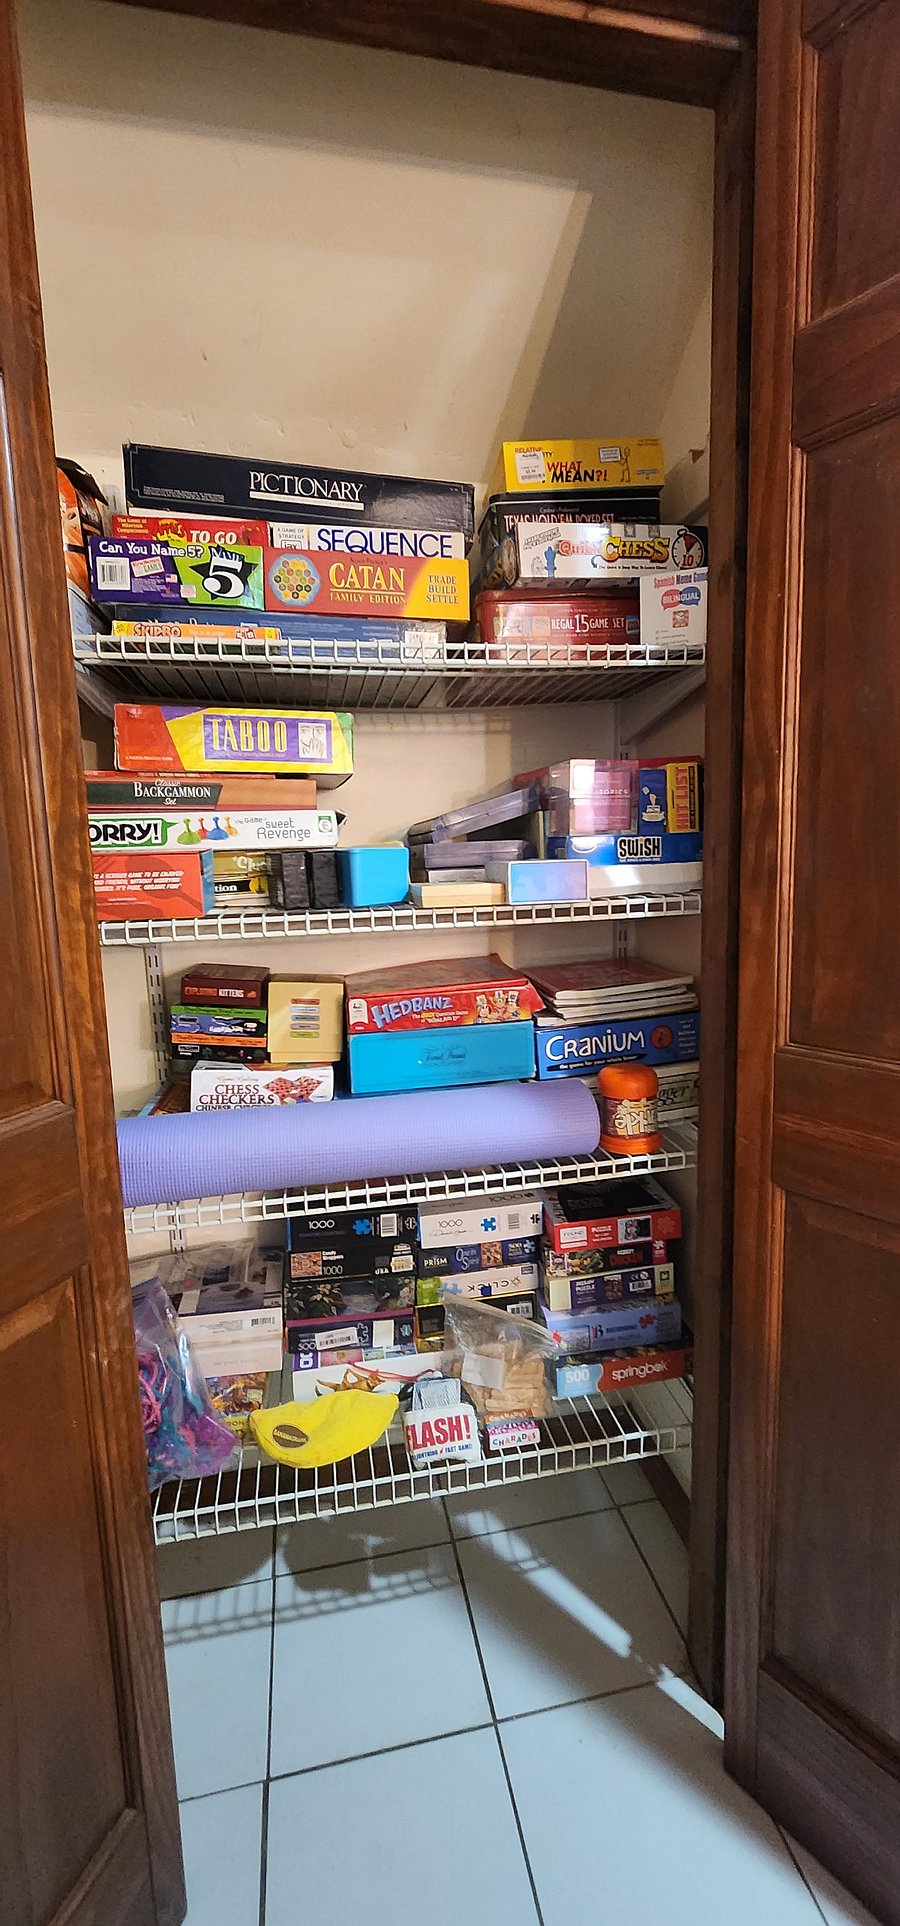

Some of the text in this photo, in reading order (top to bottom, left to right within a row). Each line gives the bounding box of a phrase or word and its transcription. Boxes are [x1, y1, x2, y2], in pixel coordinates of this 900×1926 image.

[547, 461, 582, 472] WHAT
[551, 469, 609, 483] MEAN?!
[249, 471, 364, 501] PICTIONARY
[190, 530, 237, 545] TO GO
[317, 528, 452, 558] SEQUENCE
[99, 541, 204, 558] Can You Name 5?
[682, 554, 694, 567] 10
[203, 555, 245, 599] 5
[328, 562, 405, 591] CATAN
[428, 575, 456, 584] TRADE
[654, 576, 675, 588] Spanish
[428, 585, 456, 594] BUILD
[330, 592, 406, 605] FAMILY EDITION
[426, 595, 458, 604] SETTLE
[663, 592, 699, 604] BILINGUAL
[551, 613, 625, 633] REGAL 15 GAME SET
[208, 718, 287, 752] TABOO
[134, 781, 211, 798] BACKGAMMON
[675, 767, 689, 800] LIST
[163, 797, 177, 806] Set
[265, 817, 295, 829] sweet
[88, 823, 160, 842] ORRY!
[257, 827, 311, 841] Revenge
[214, 883, 237, 892] tion
[218, 988, 245, 998] KITTENS
[371, 996, 453, 1029] HEDBANZ
[214, 1084, 259, 1095] CHESS
[199, 1094, 275, 1105] CHECKERS
[308, 1219, 335, 1229] 1000
[439, 1218, 463, 1229] 1000
[424, 1257, 448, 1267] PRISM
[323, 1265, 343, 1275] 1000
[467, 1280, 509, 1293] CLCK
[298, 1342, 316, 1351] 500
[565, 1370, 589, 1383] 500
[612, 1360, 668, 1381] springbok
[492, 1432, 536, 1446] CHARADES
